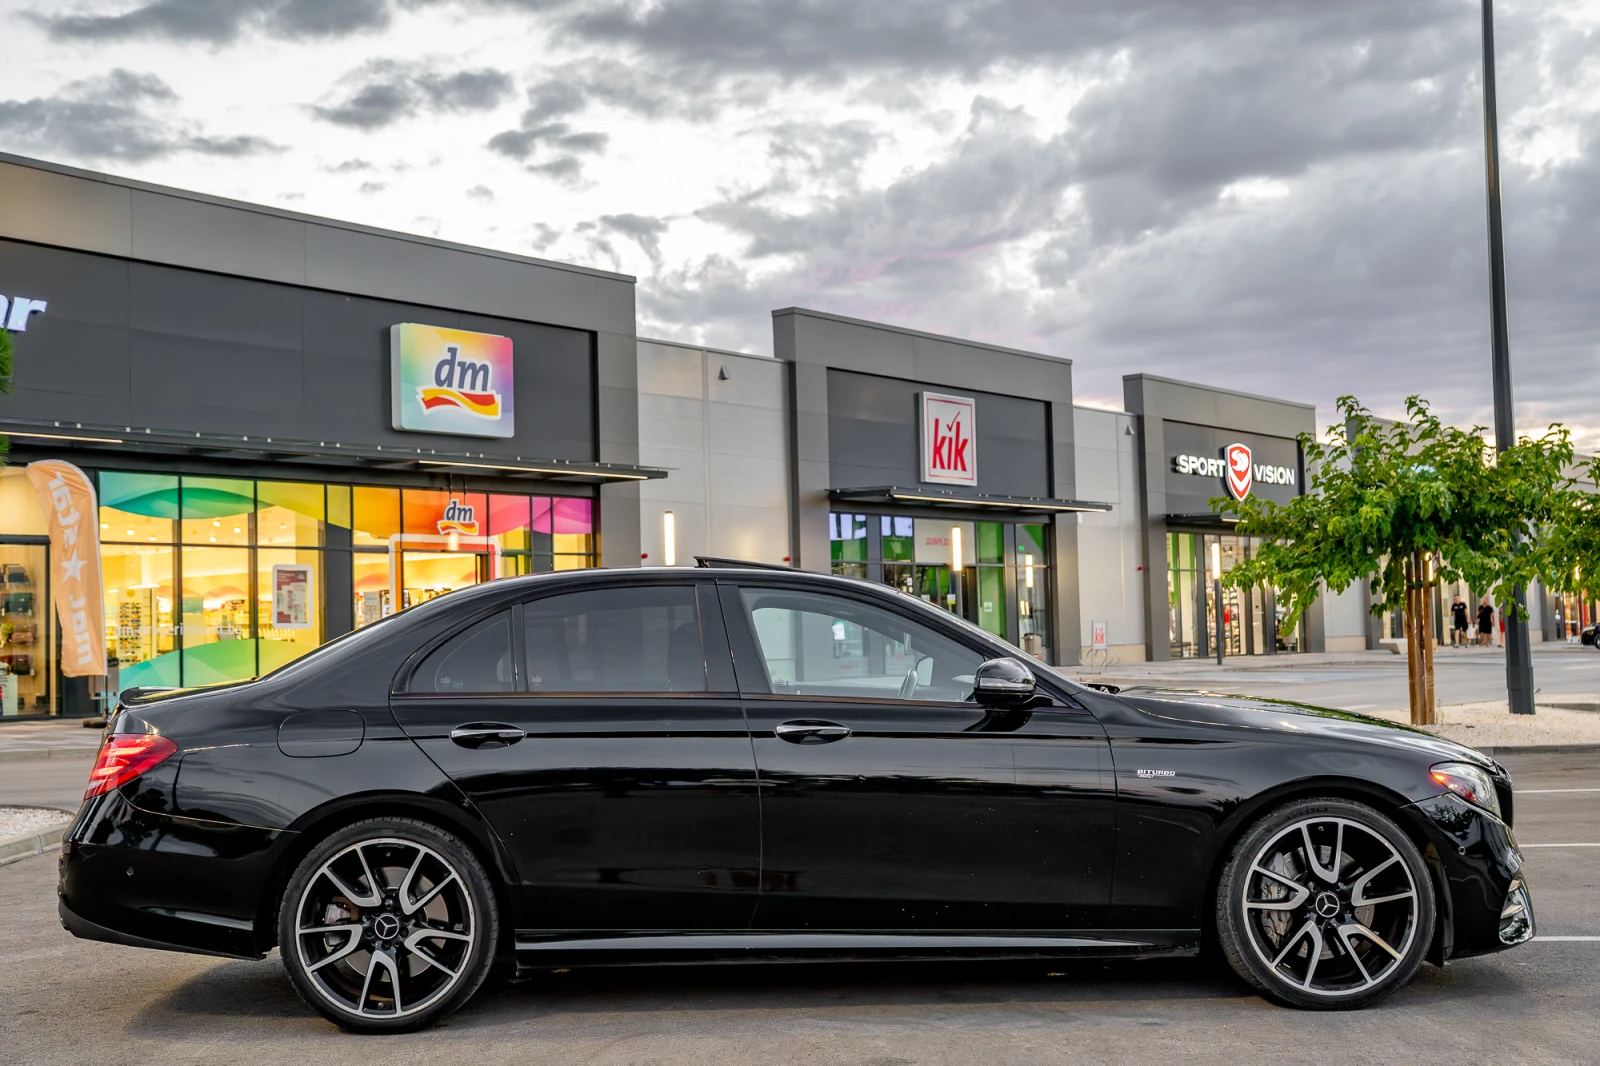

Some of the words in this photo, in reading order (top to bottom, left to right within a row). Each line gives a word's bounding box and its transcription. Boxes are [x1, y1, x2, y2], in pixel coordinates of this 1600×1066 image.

[433, 347, 491, 392] dm
[932, 412, 969, 472] kik
[1177, 454, 1225, 477] SPORT
[1252, 464, 1295, 486] VISION
[446, 501, 473, 523] dm
